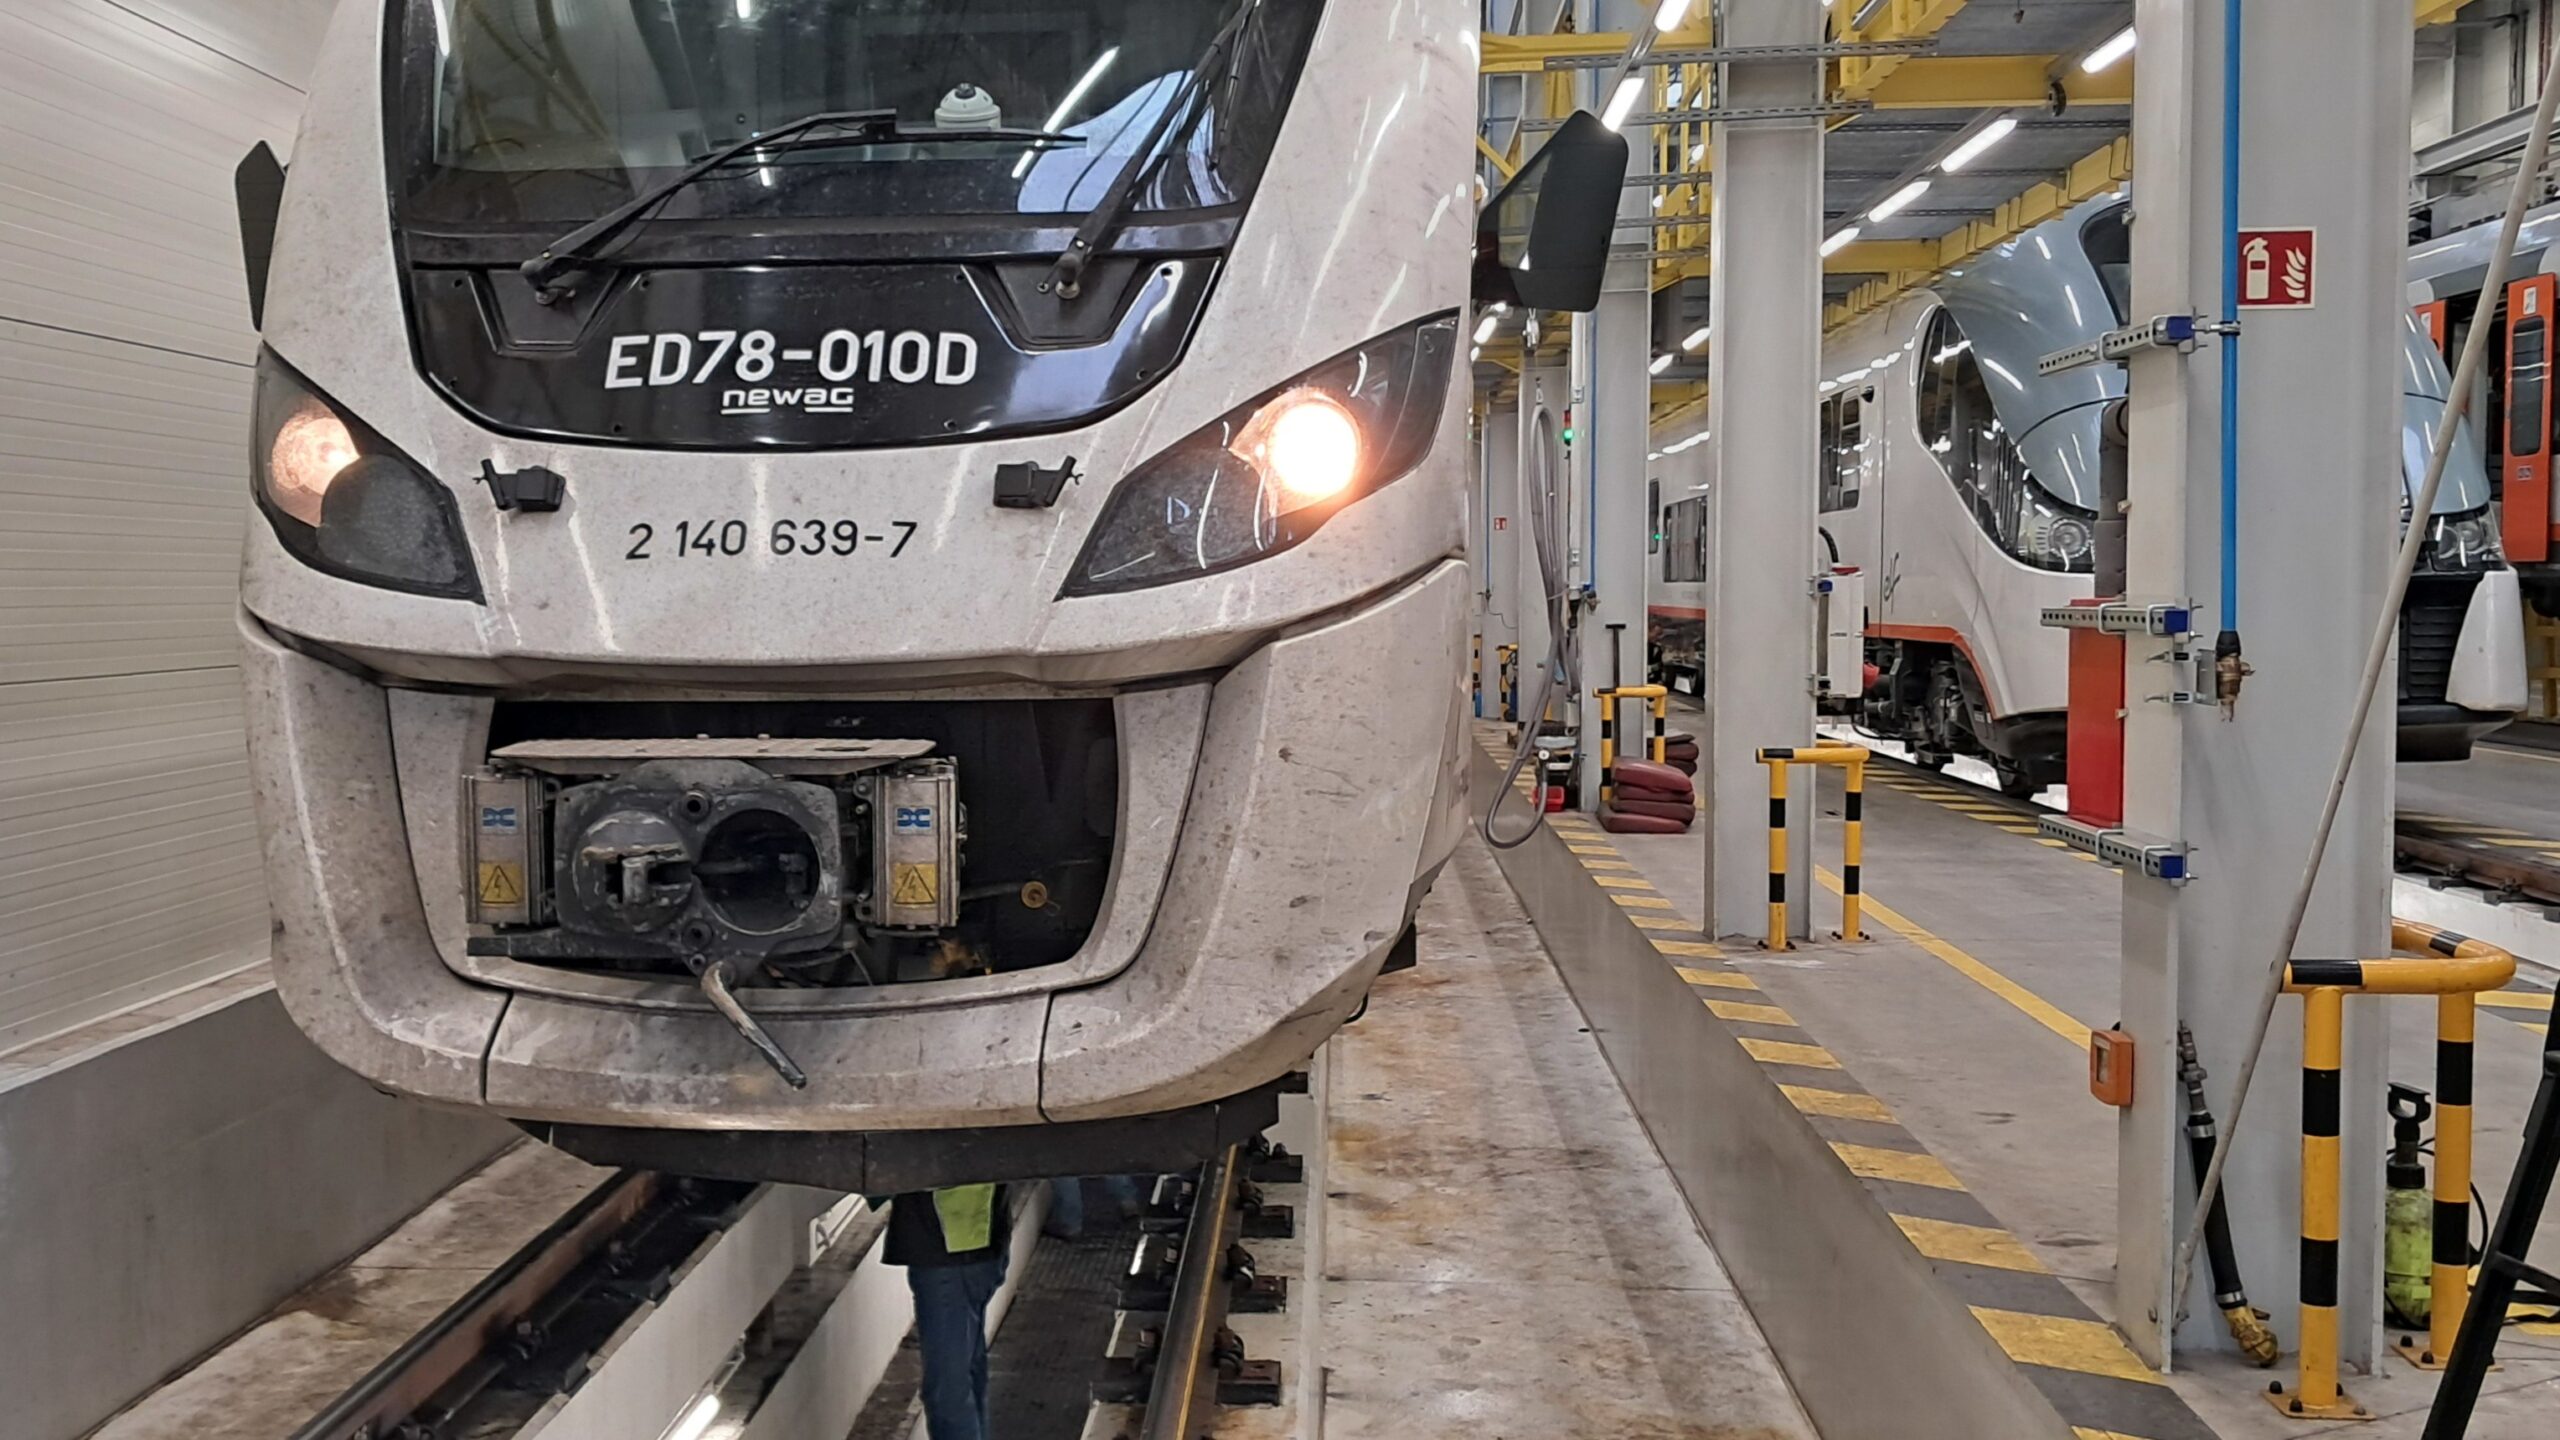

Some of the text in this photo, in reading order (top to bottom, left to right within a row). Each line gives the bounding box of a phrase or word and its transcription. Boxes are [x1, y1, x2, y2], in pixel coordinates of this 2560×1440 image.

[604, 329, 979, 389] ED78-010D
[625, 518, 919, 560] 2 140 639-7
